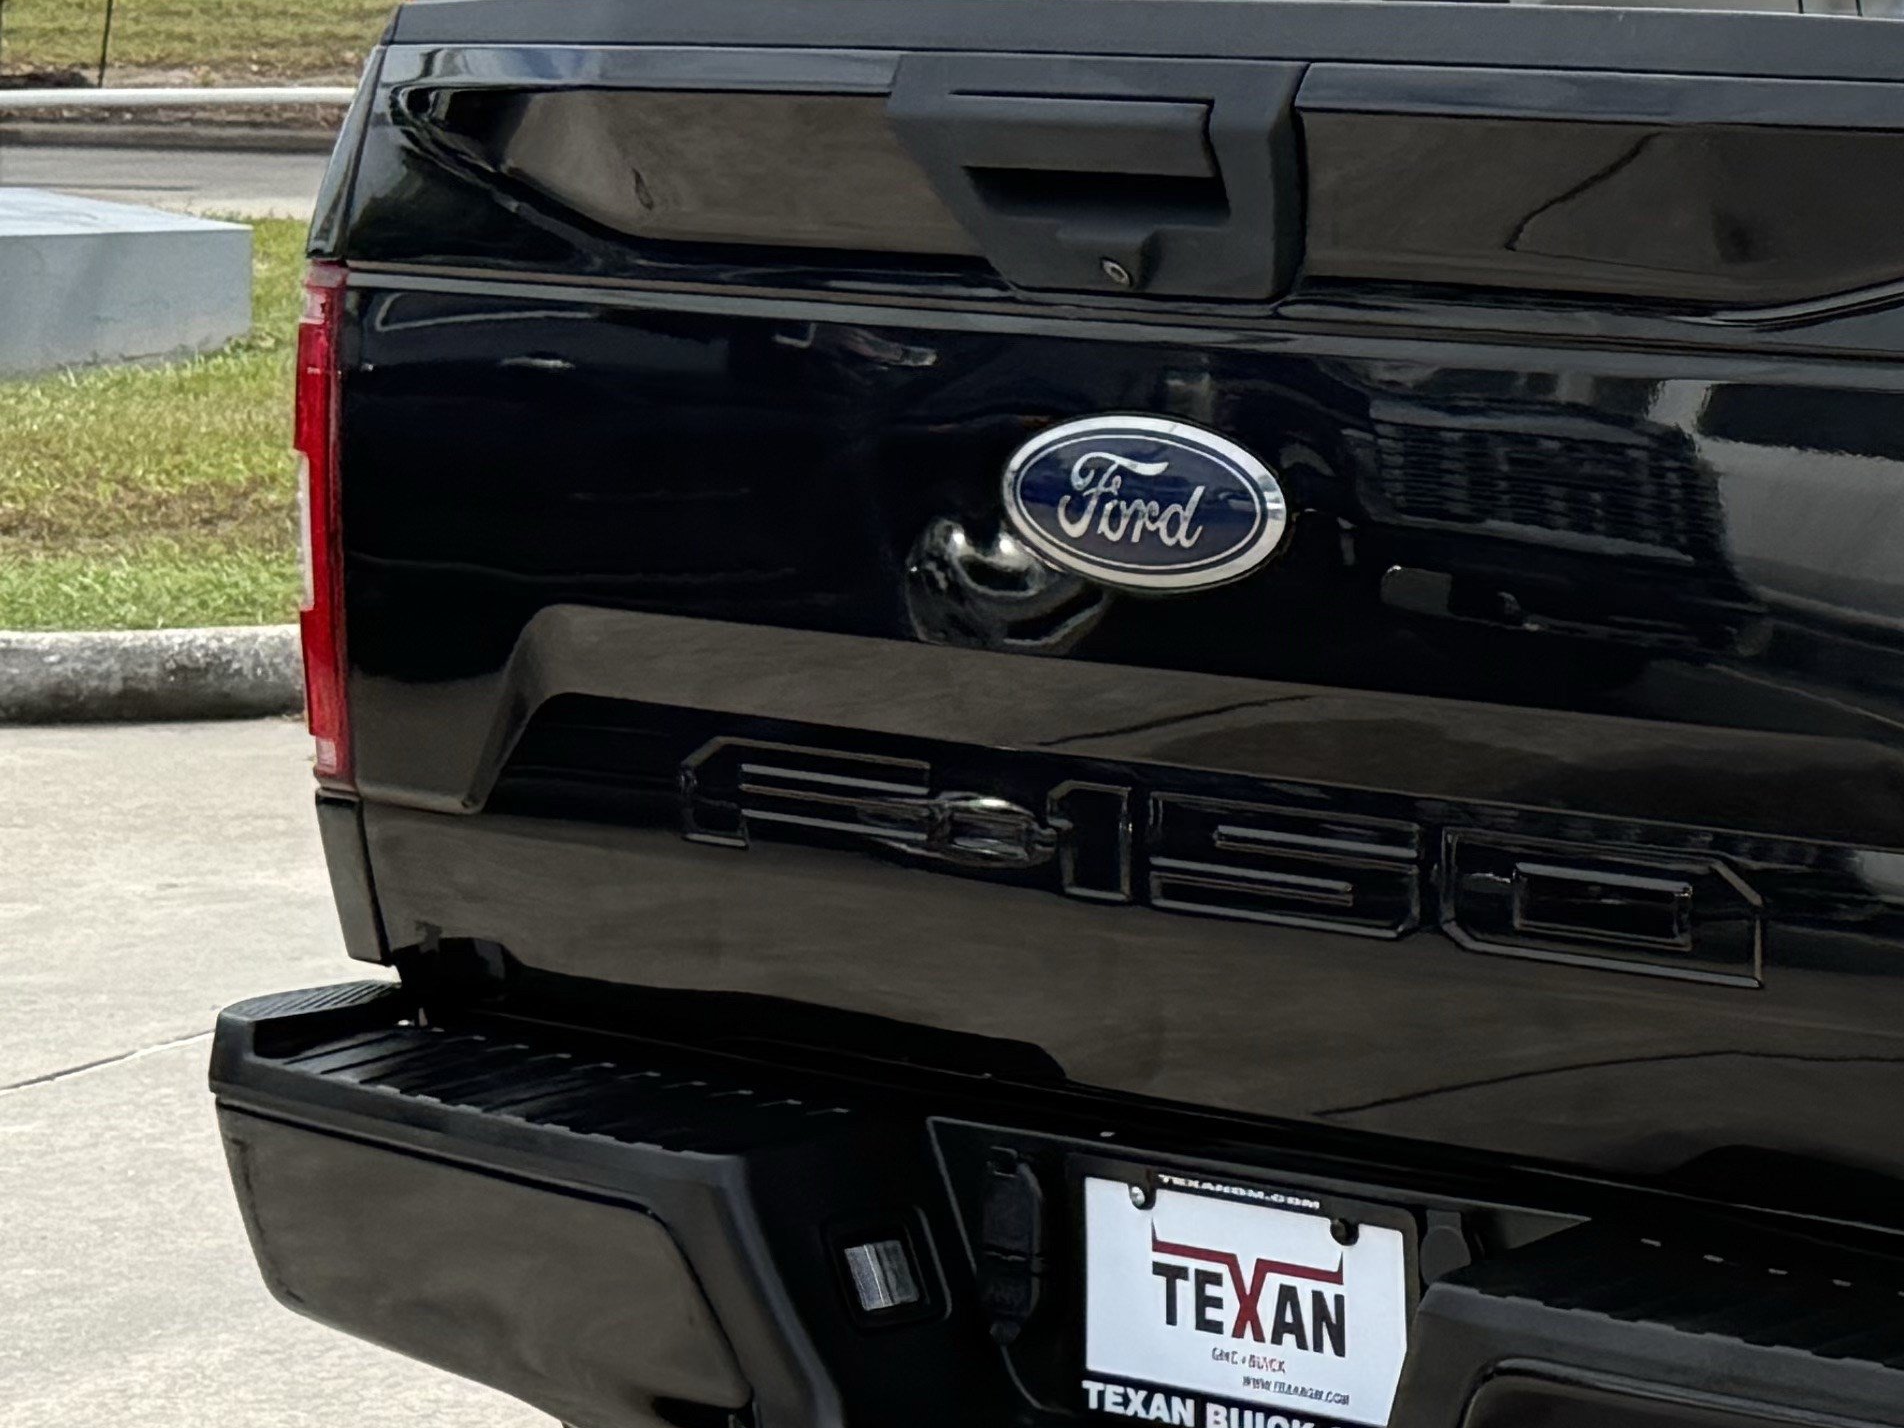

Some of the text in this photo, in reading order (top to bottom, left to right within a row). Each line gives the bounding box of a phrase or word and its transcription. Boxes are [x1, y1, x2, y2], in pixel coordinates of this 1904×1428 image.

[1057, 451, 1206, 549] Ford
[1152, 1237, 1345, 1358] TEXAN
[1082, 1380, 1195, 1428] TEXAN
